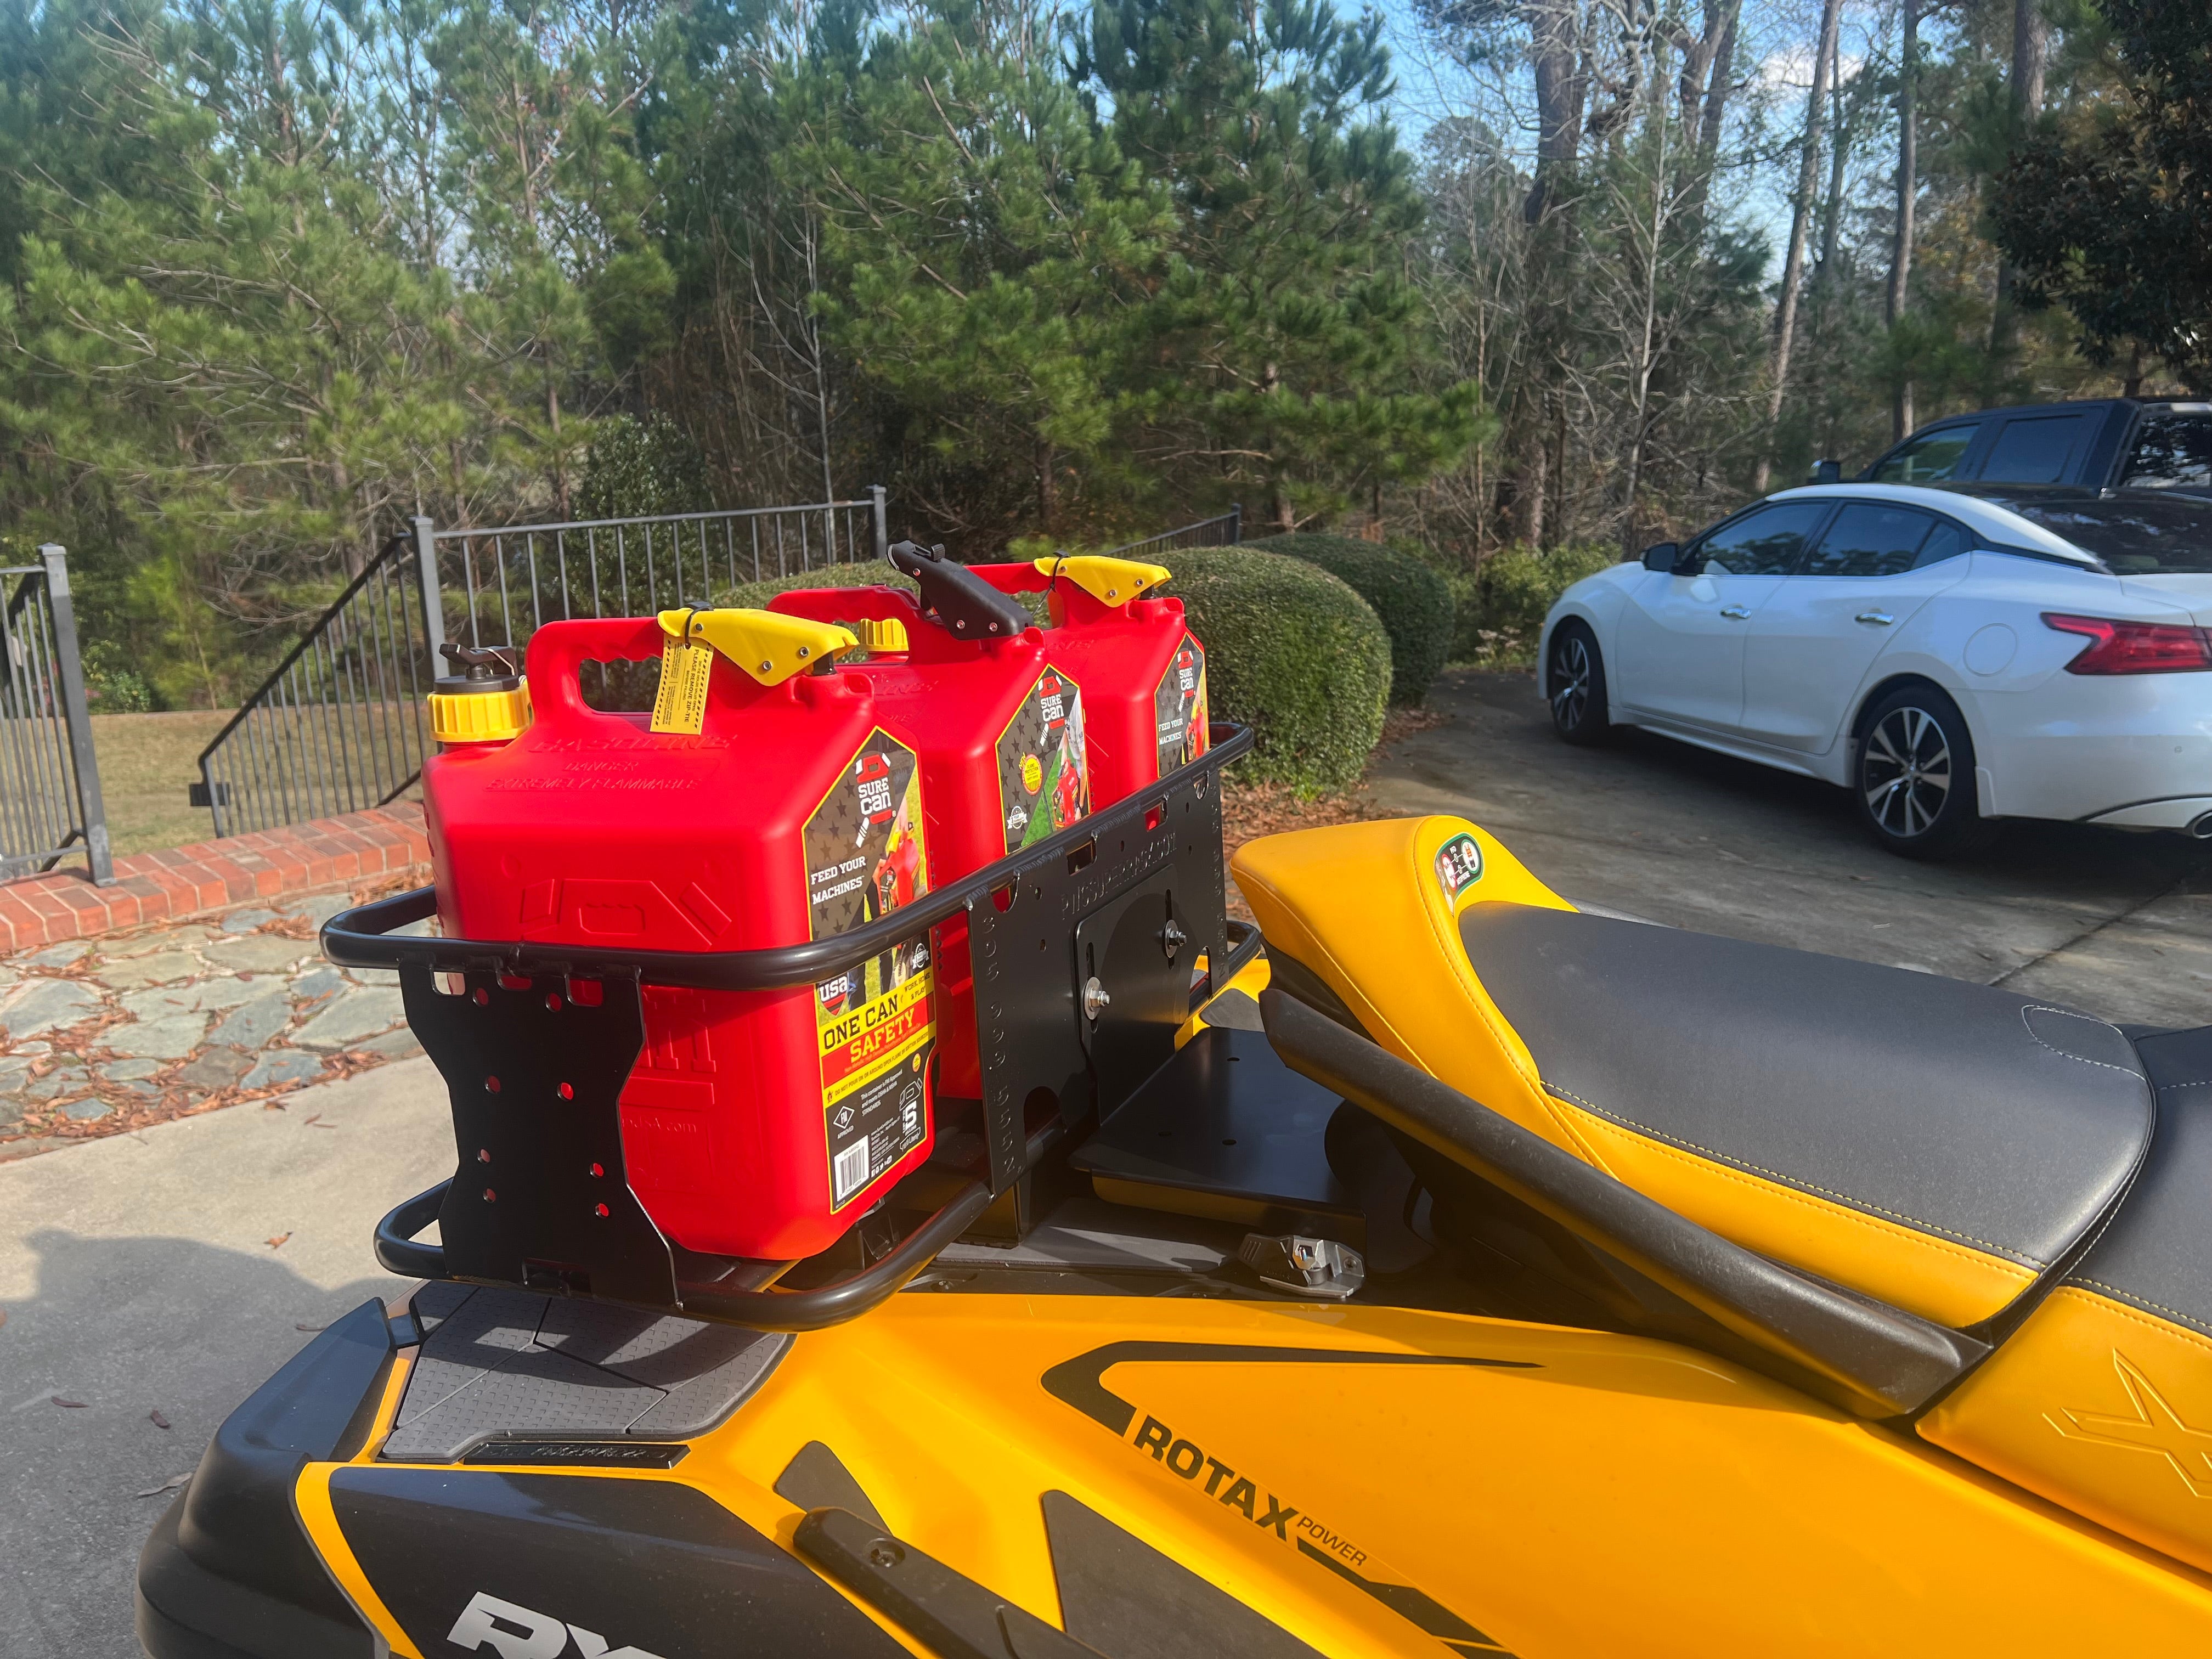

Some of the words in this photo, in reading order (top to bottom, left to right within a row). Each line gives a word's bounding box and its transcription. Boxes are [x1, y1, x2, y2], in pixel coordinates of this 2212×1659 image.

[691, 649, 699, 672] PLEASE
[1179, 668, 1193, 679] SURE
[687, 673, 696, 699] REMOVE
[1040, 693, 1062, 709] SURE
[1158, 721, 1170, 732] FEED
[1171, 717, 1183, 729] YOUR
[564, 760, 640, 772] DANGER
[486, 778, 591, 791] EXTREMELY
[592, 777, 702, 791] FLAMMABLE
[857, 778, 889, 799] SURE
[811, 866, 838, 885] FEED
[839, 856, 866, 876] YOUR
[812, 876, 863, 905] MACHINES
[915, 986, 927, 997] PLAY
[824, 1014, 860, 1049] ONE
[866, 994, 898, 1028] CAN
[850, 1007, 914, 1063] SAFETY
[905, 1099, 917, 1131] 5
[1132, 1414, 1300, 1542] ROTAX
[1296, 1515, 1367, 1567] POWER
